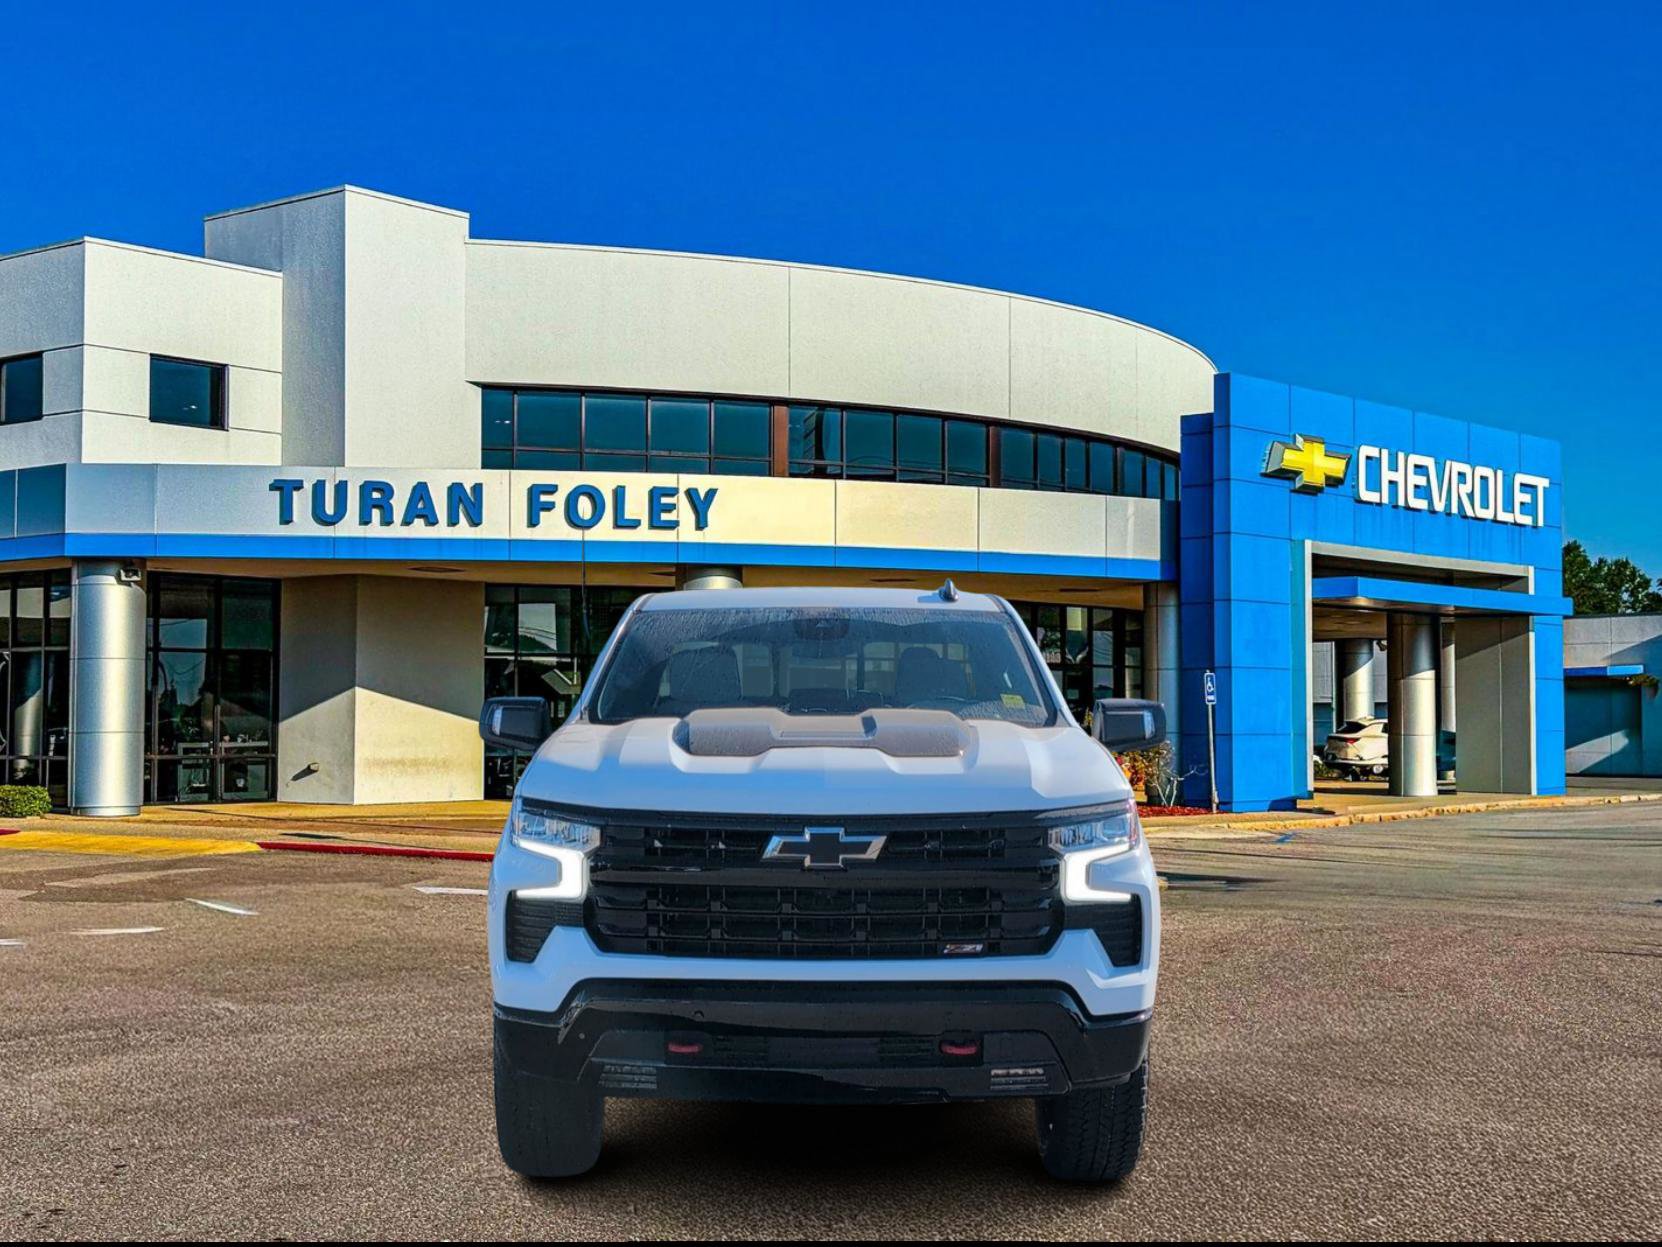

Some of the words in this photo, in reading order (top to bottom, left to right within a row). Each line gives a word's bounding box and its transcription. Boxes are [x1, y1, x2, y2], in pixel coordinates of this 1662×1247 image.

[269, 479, 483, 527] TURAN
[527, 484, 718, 531] FOLEY
[1357, 444, 1550, 527] CHEVROLET
